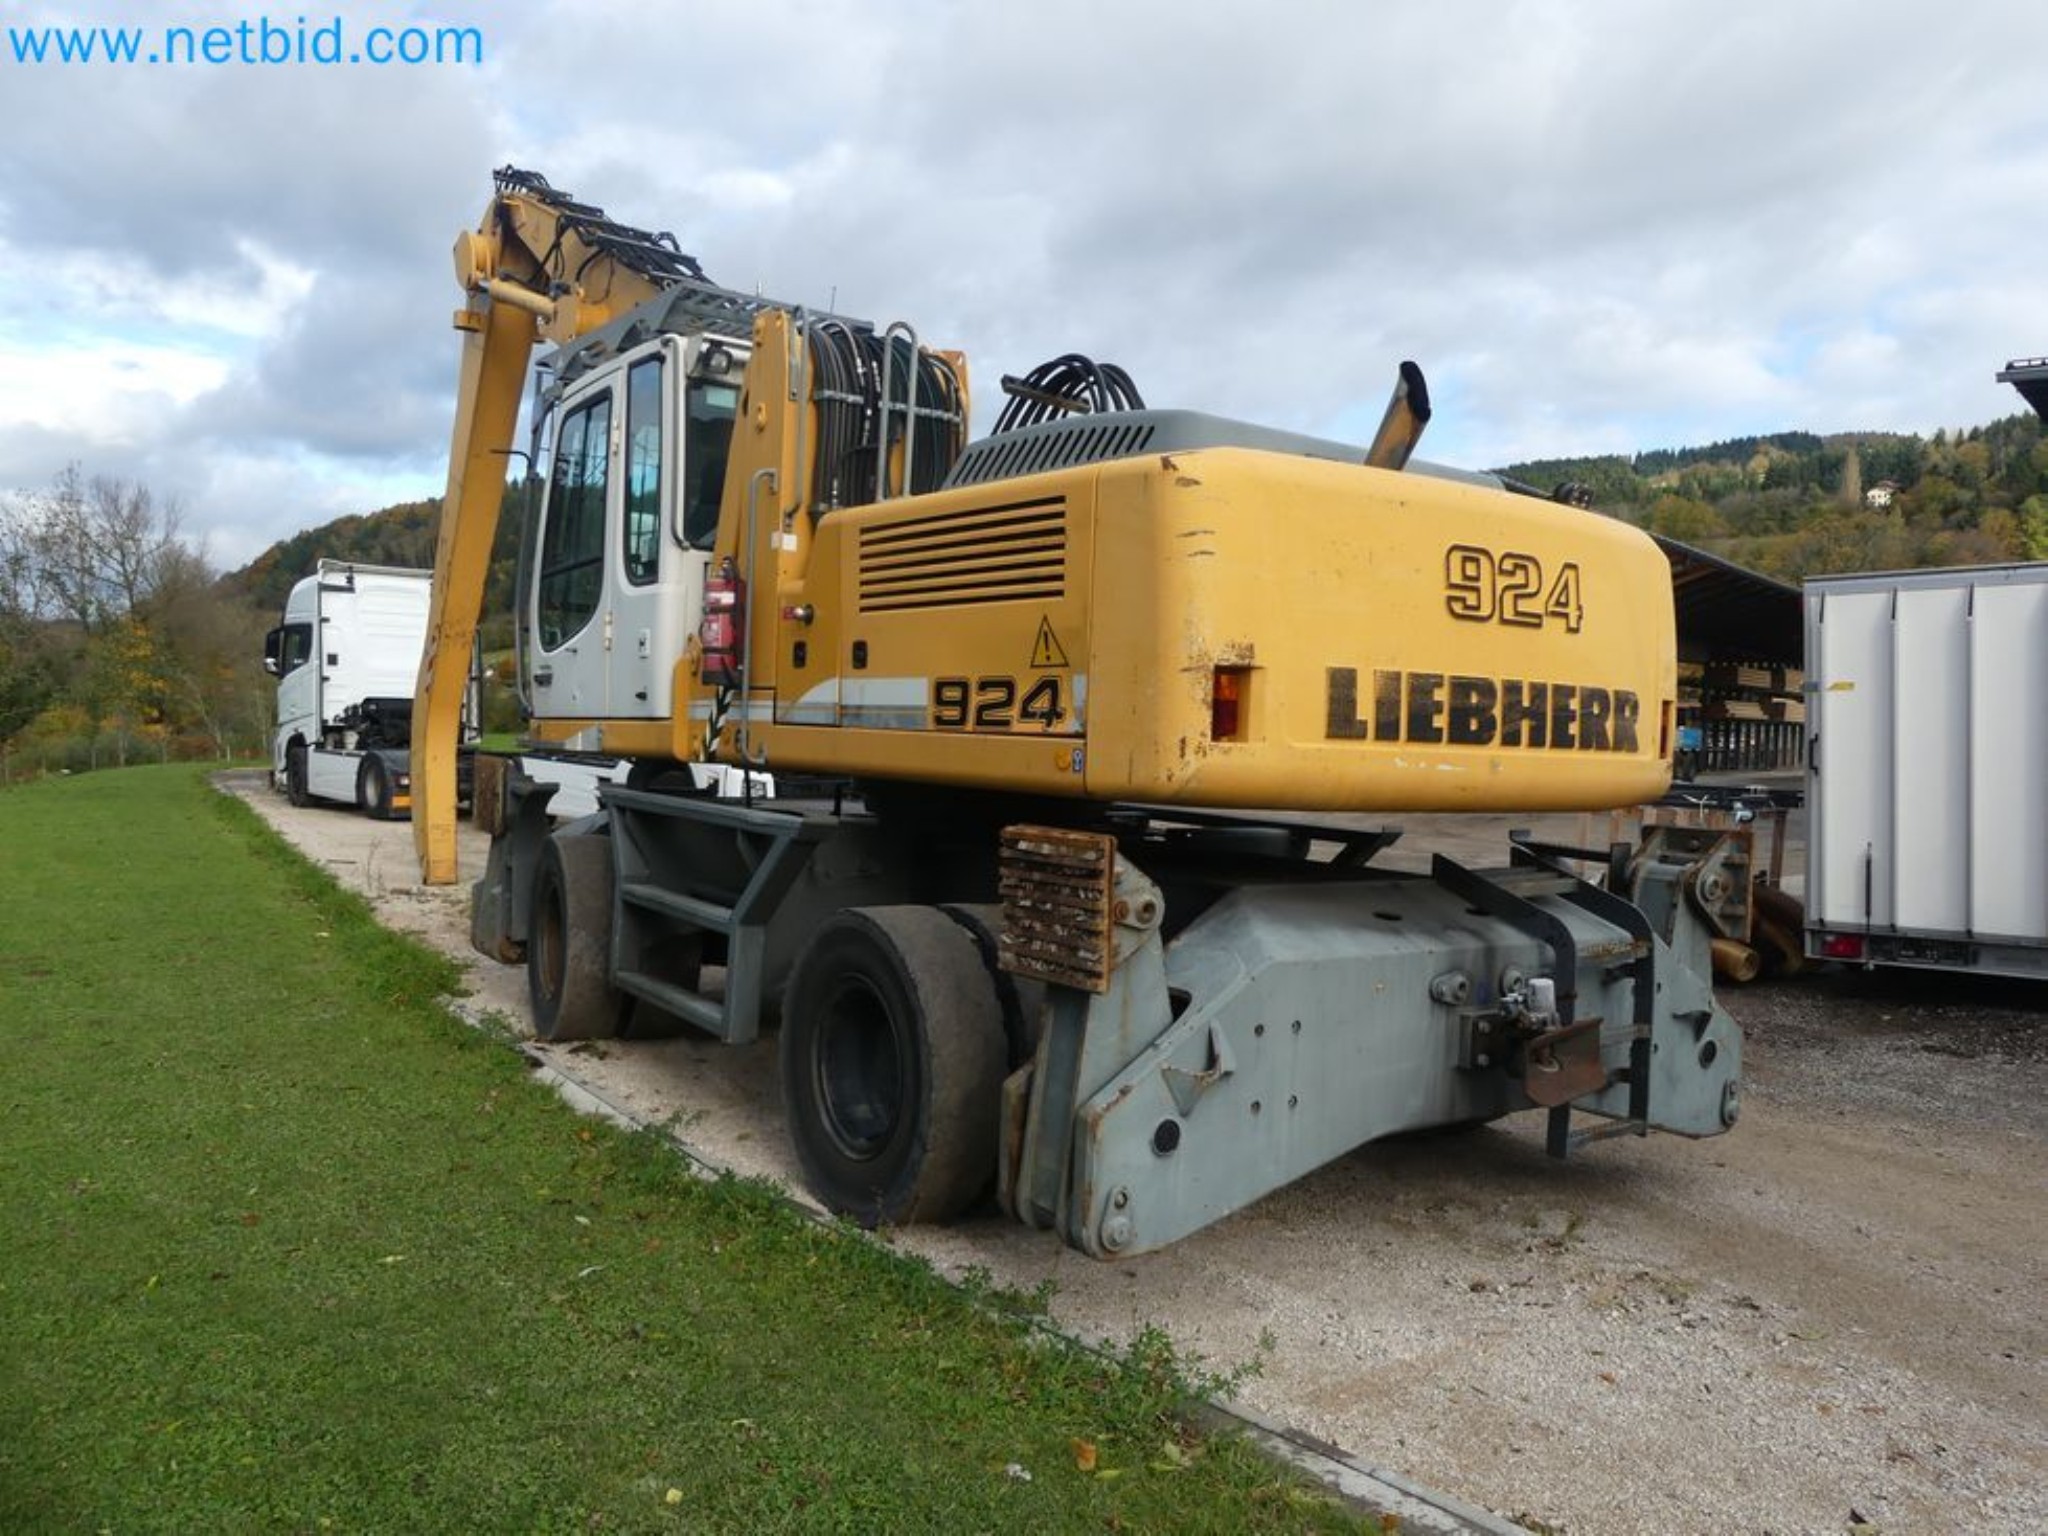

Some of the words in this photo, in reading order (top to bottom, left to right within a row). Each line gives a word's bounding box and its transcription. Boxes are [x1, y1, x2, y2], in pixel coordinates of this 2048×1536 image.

[1446, 544, 1583, 634] 924
[933, 676, 1065, 731] 924
[1326, 667, 1639, 753] LIEBHERR
